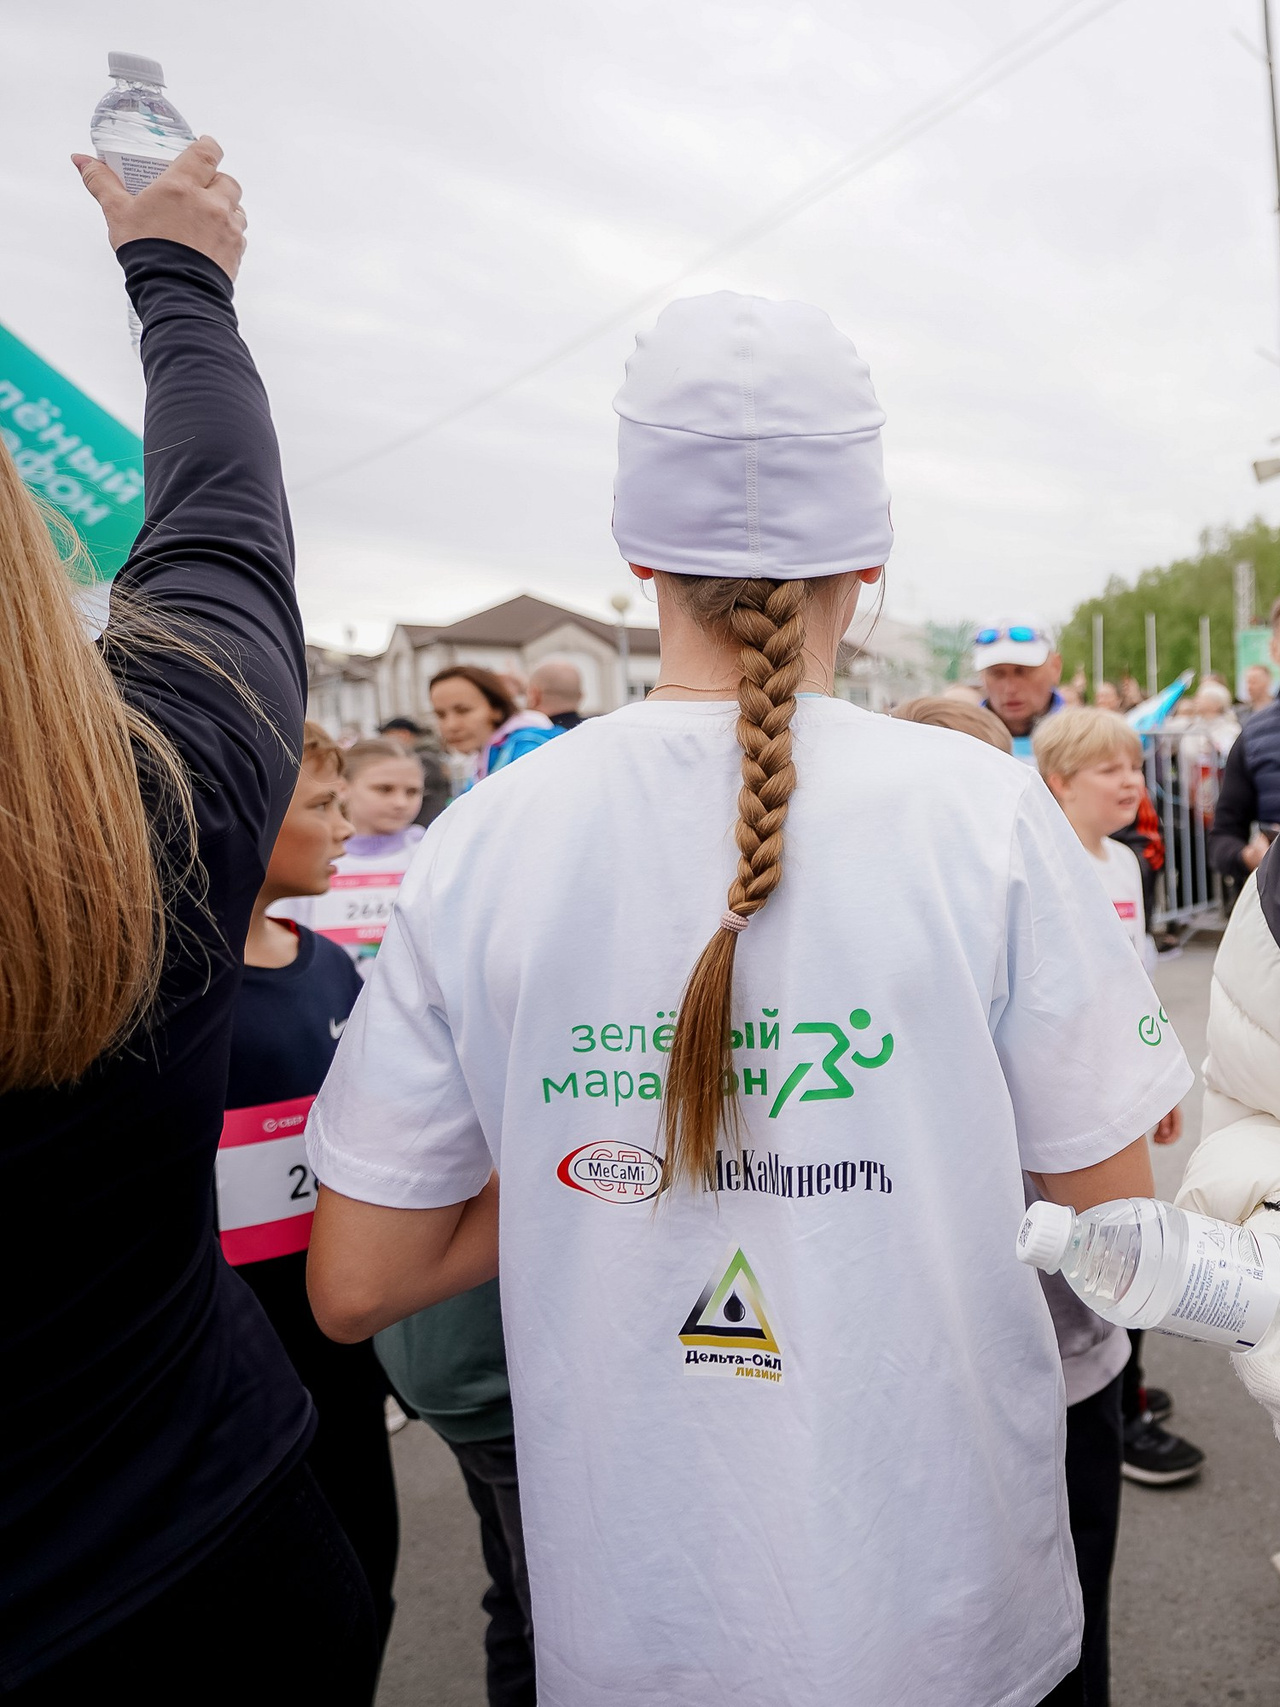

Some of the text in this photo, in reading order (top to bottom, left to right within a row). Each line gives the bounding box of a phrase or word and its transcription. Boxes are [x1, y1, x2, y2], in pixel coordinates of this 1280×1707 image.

[570, 1008, 780, 1053] зелёый
[543, 1067, 768, 1107] мараон
[288, 1164, 318, 1201] 2
[588, 1162, 645, 1181] MeCaMi
